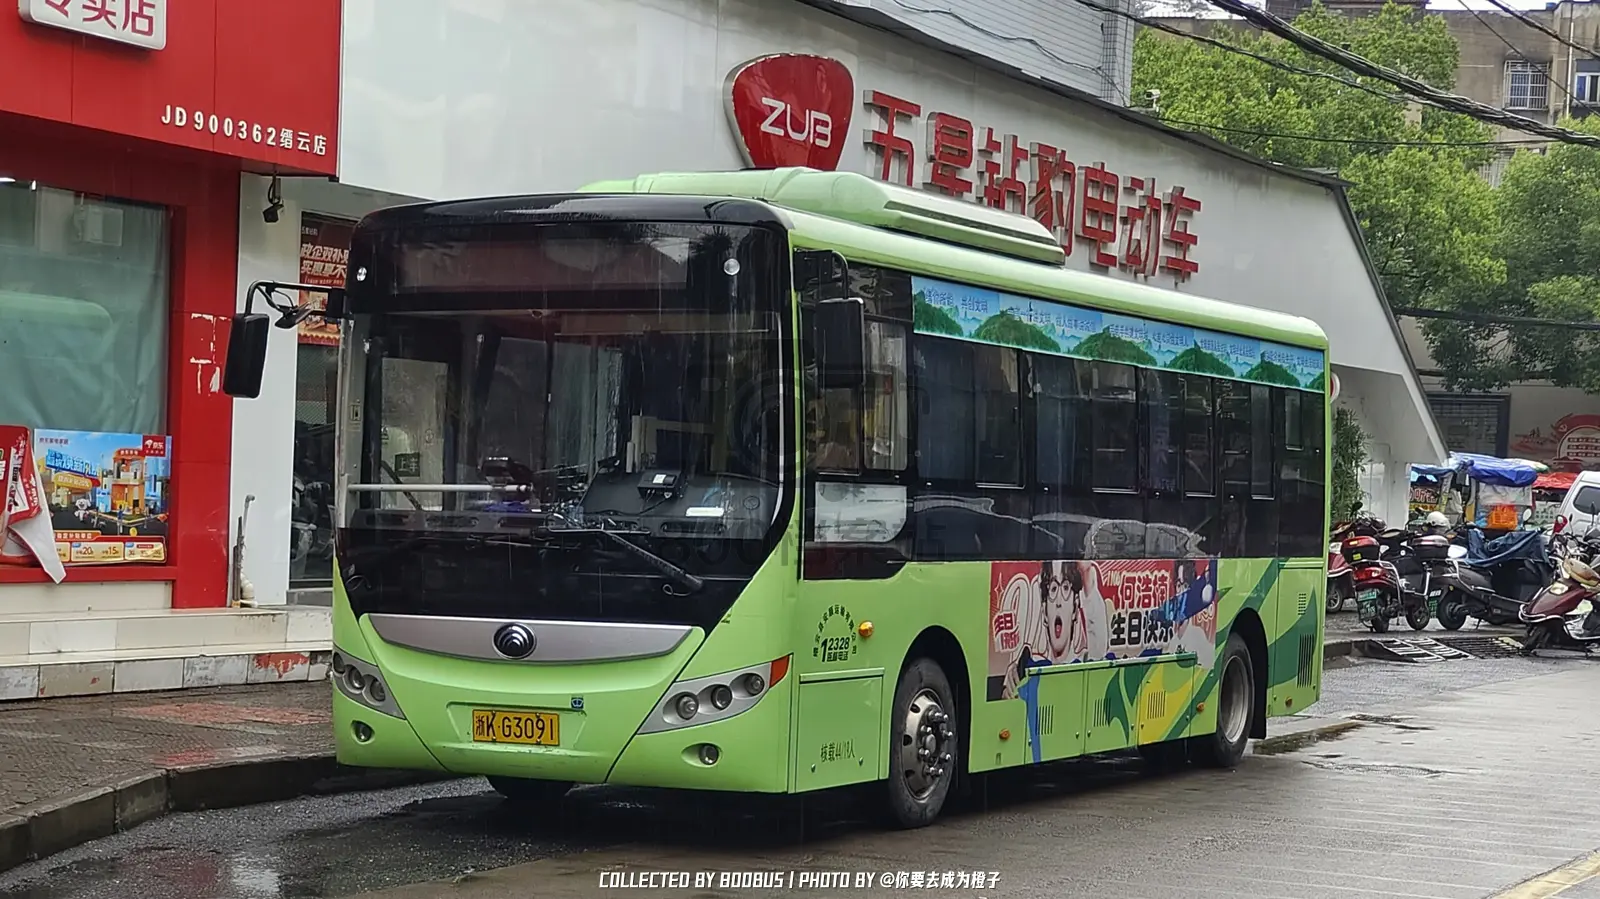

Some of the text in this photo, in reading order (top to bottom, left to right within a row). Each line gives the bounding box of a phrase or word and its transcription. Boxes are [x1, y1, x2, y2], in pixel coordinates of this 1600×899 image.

[863, 89, 1202, 283] 五星钻豹电动车
[820, 636, 850, 663] 12328
